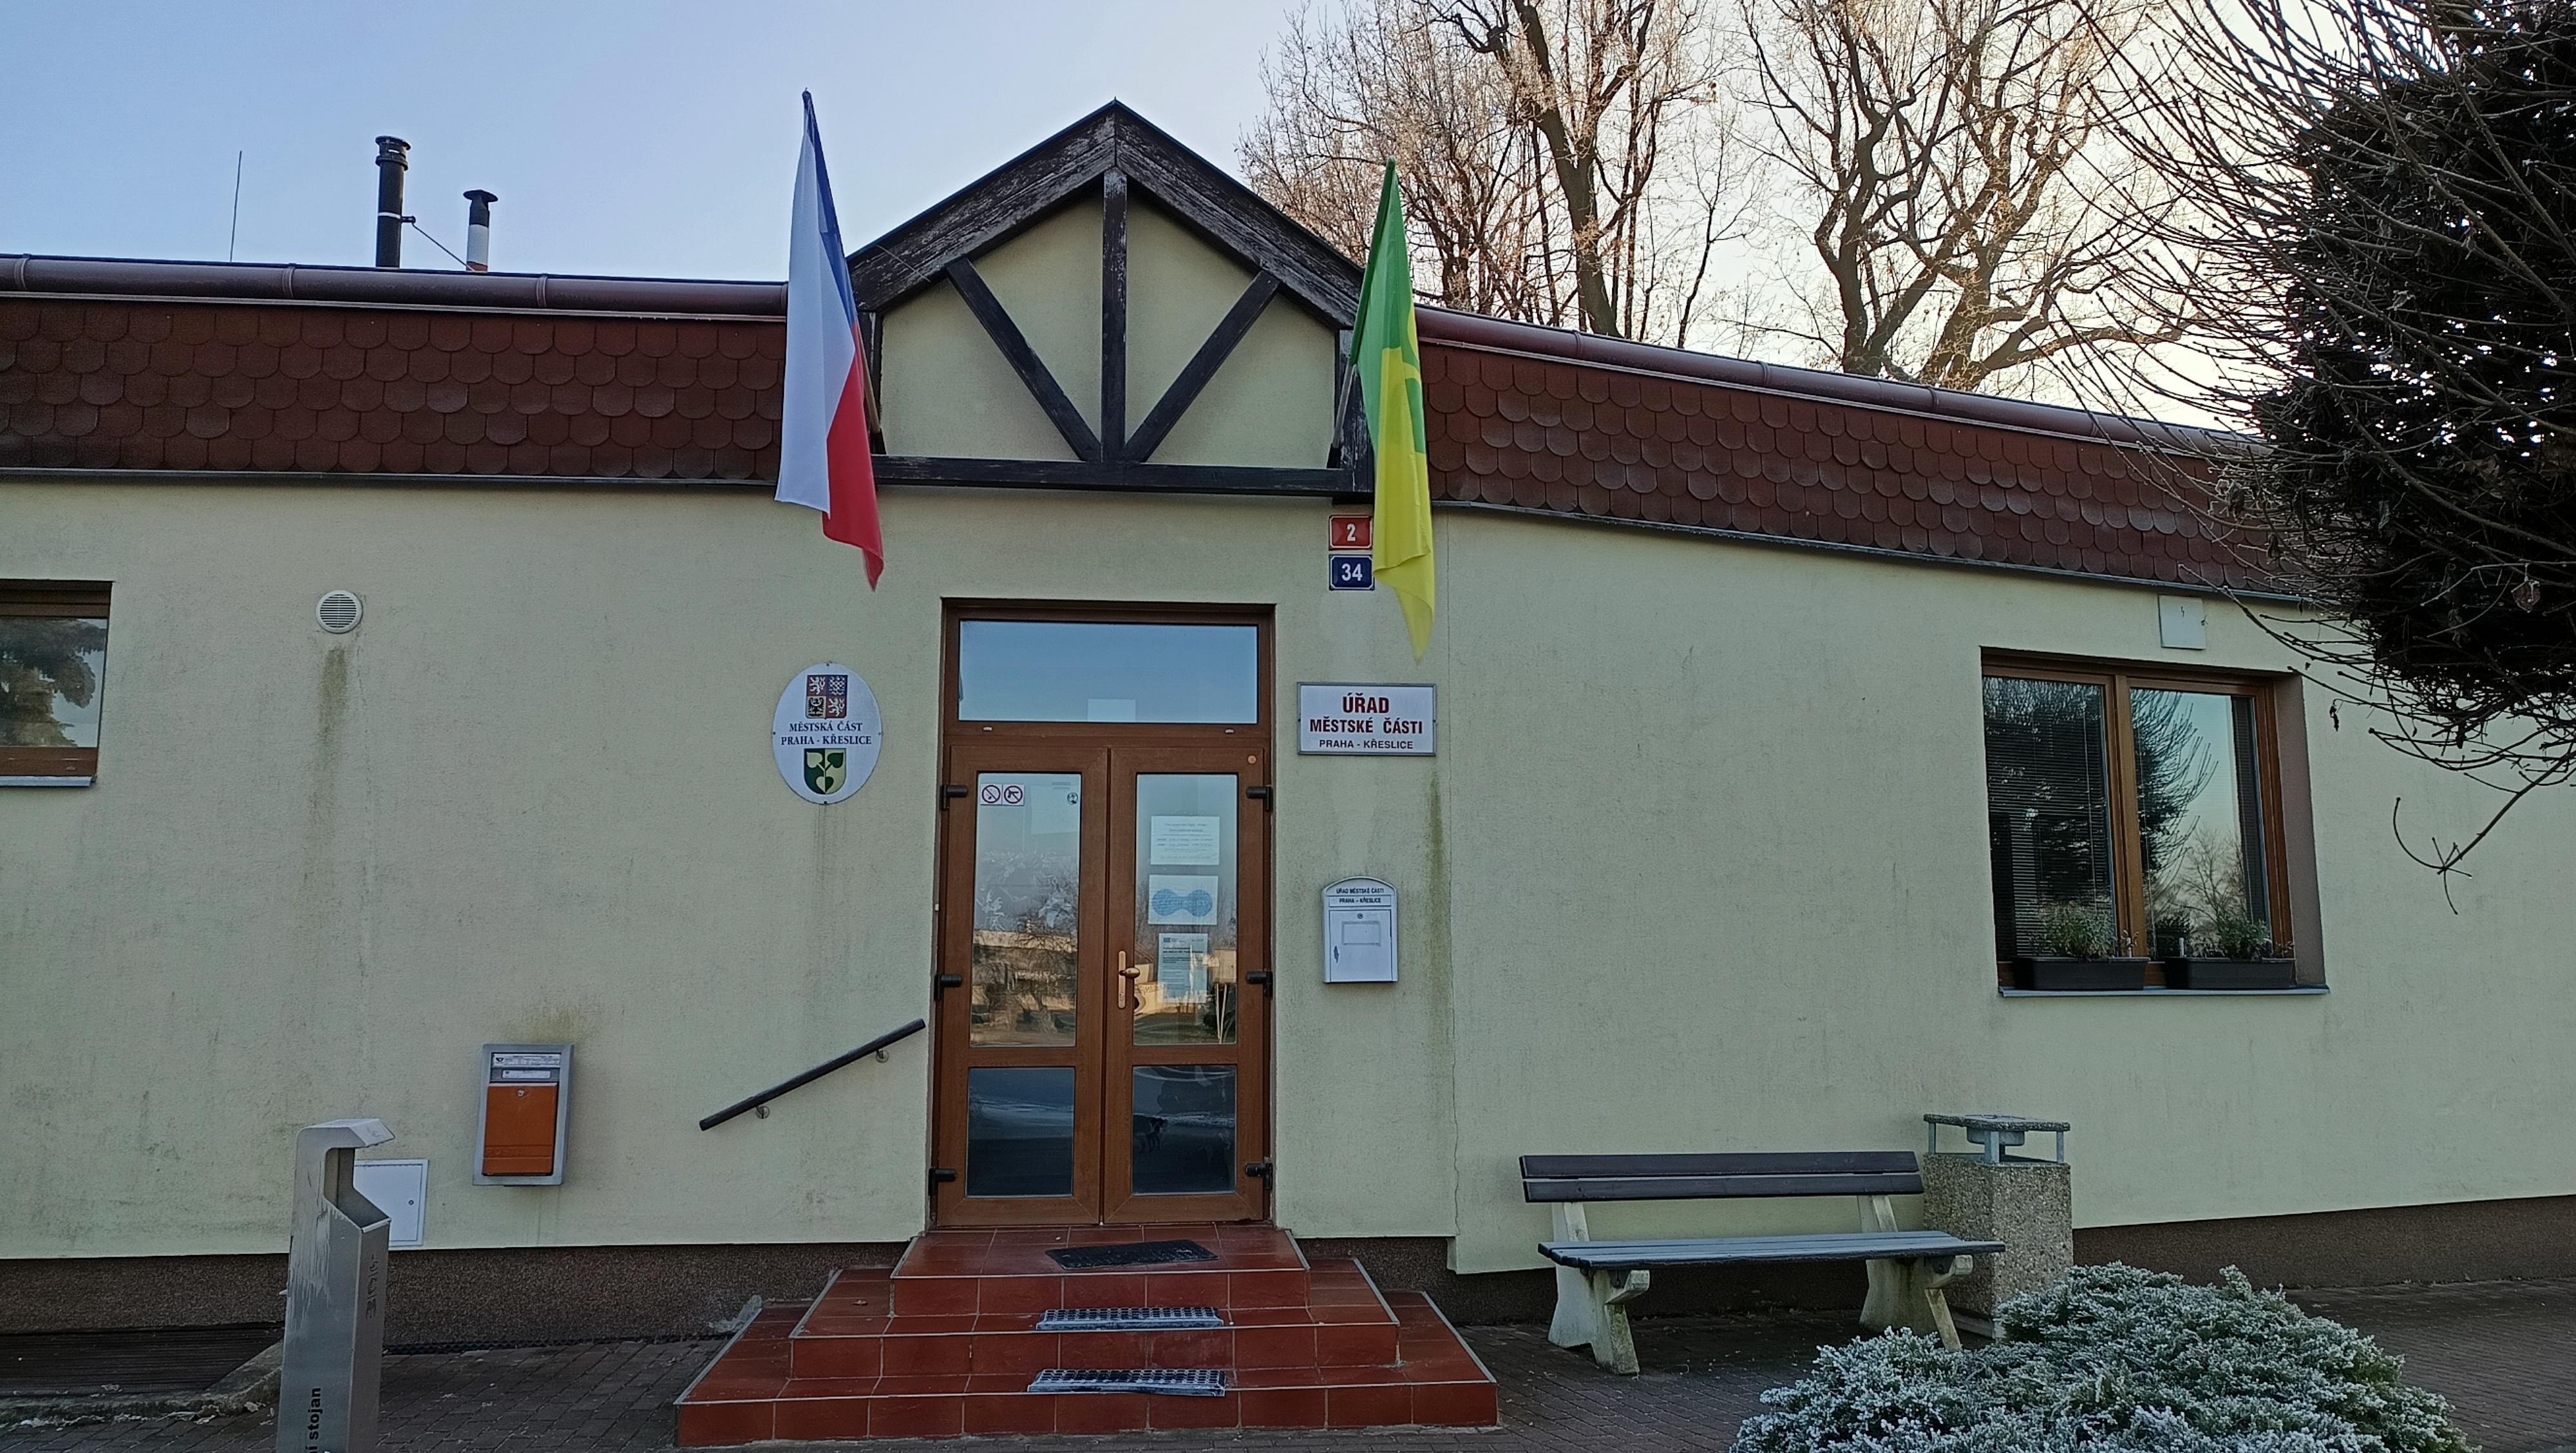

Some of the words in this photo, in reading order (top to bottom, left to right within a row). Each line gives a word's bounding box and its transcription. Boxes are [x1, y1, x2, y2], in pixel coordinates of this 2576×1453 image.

[1346, 523, 1356, 542] 2
[1341, 563, 1363, 582] 34
[1342, 692, 1390, 714] ÚŘAD
[789, 721, 833, 732] MĚSTSKÁ
[837, 720, 863, 732] ČÁST
[1309, 716, 1374, 733] MĚSTSKÉ
[1383, 717, 1423, 734] ČÁSTI
[781, 736, 814, 745] PRAHA
[822, 734, 872, 745] KŘESLICE
[1319, 739, 1354, 748] PRAHA
[1363, 737, 1414, 750] KŘESLICE
[308, 1387, 323, 1440] stojan
